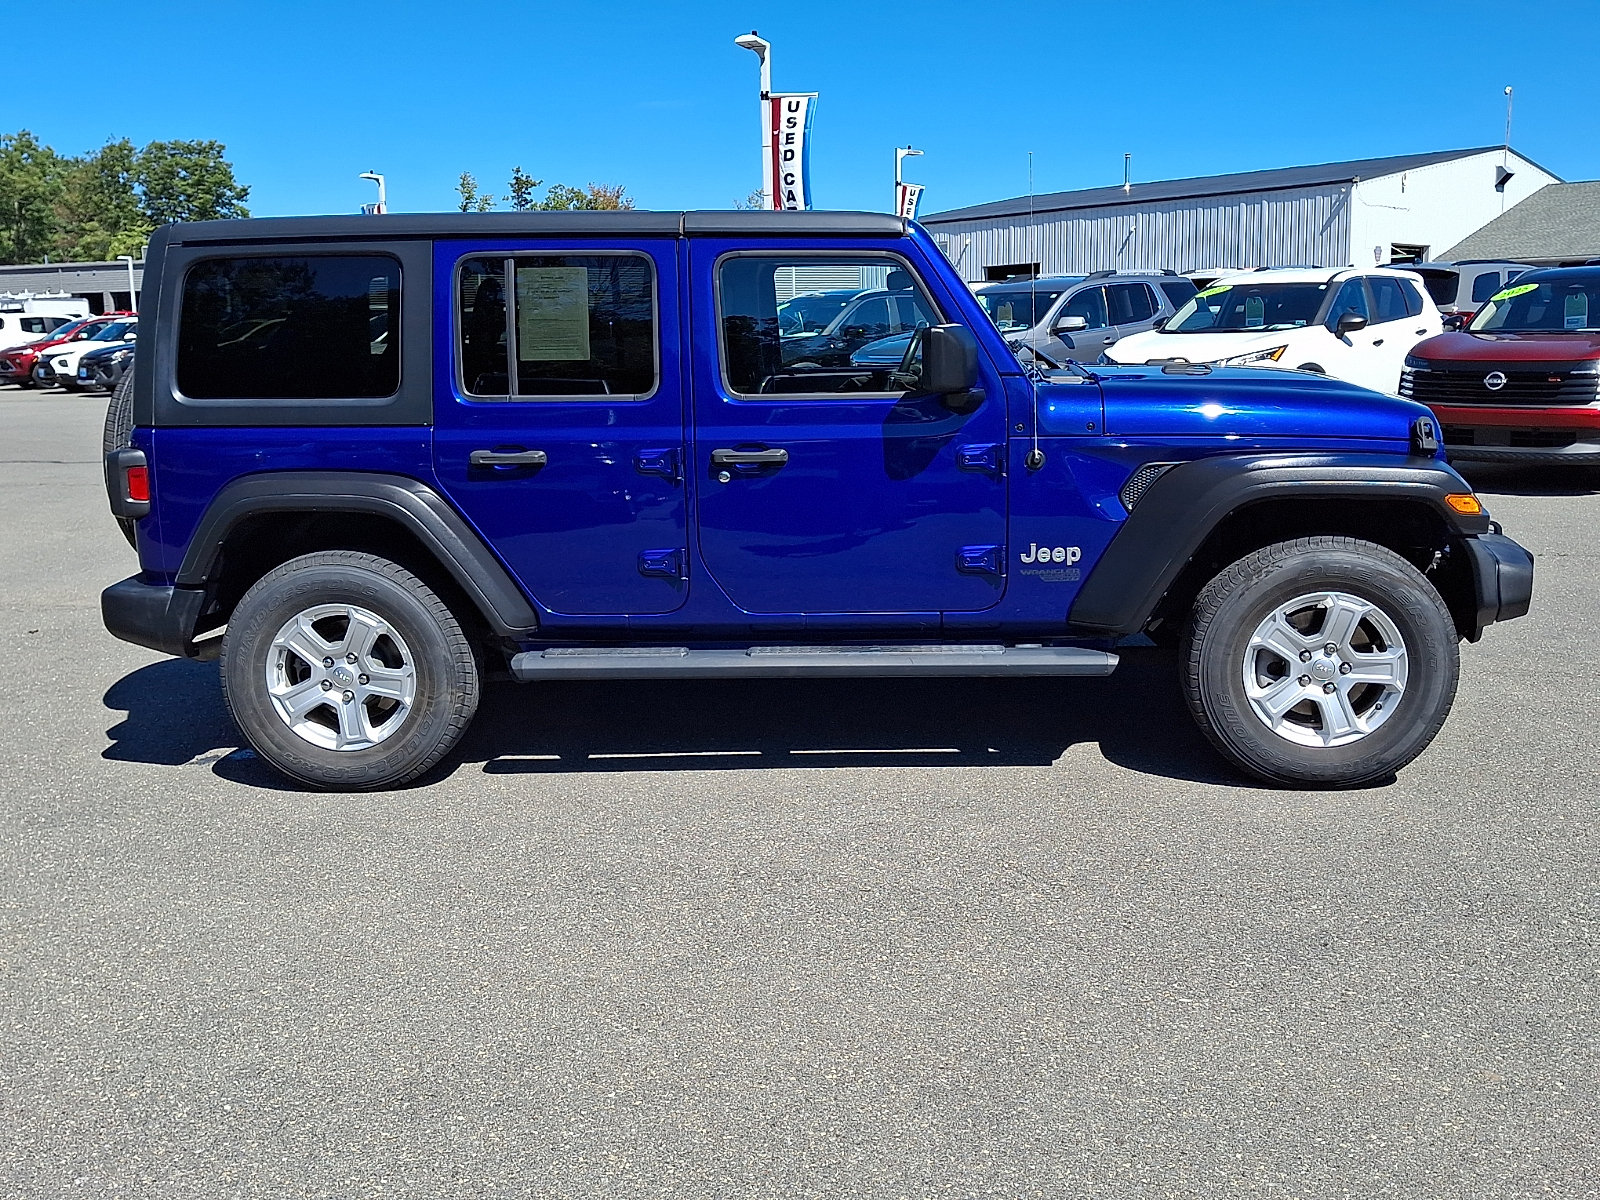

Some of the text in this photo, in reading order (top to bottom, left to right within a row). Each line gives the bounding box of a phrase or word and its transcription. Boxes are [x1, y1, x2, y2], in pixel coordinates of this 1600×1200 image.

[783, 101, 800, 210] USED CA
[1020, 543, 1081, 566] Jeep
